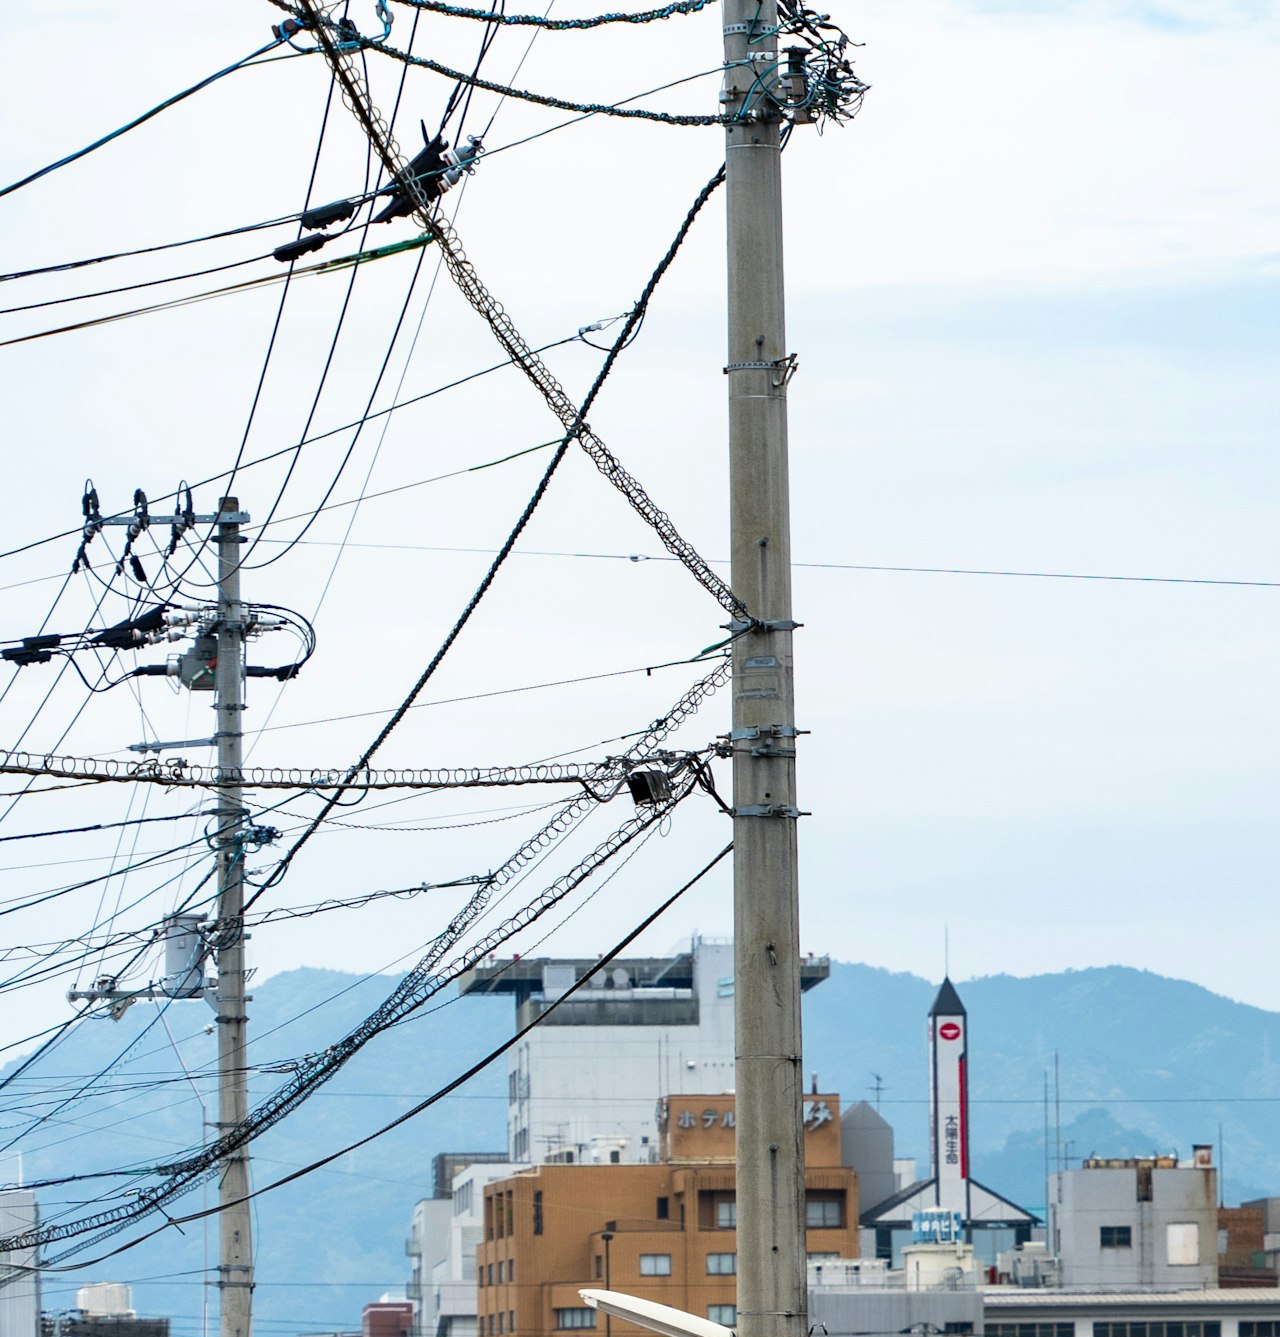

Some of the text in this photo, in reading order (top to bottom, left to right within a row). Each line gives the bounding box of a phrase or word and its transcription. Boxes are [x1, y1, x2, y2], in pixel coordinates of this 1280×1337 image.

[677, 1109, 736, 1129] ホテル
[945, 1114, 959, 1165] 太陽生命
